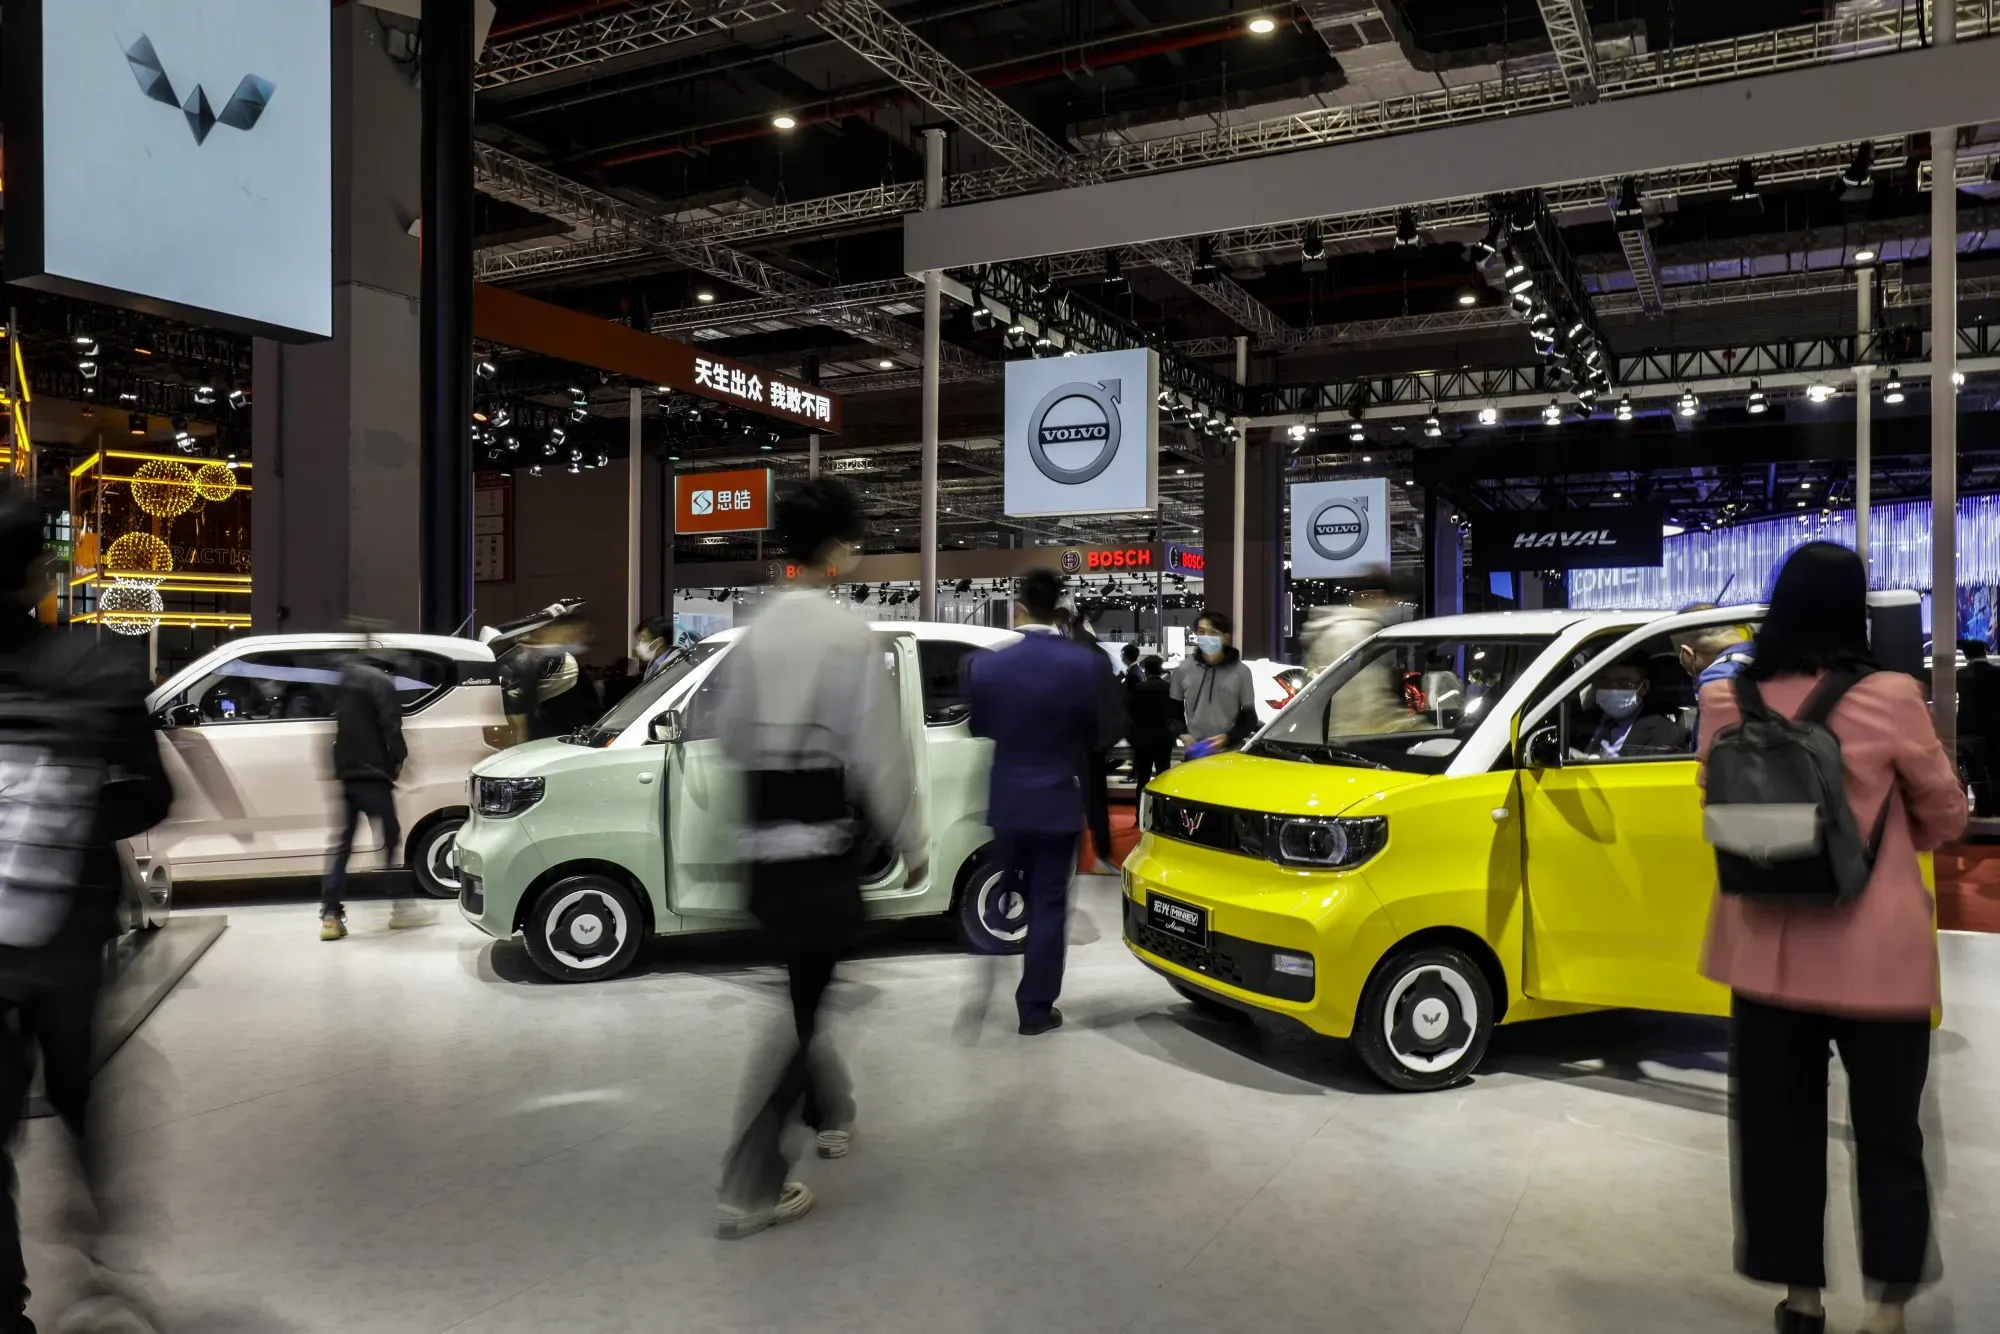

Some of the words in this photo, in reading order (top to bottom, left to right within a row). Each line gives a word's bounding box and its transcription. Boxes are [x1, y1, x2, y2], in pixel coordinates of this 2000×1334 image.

[695, 357, 763, 402] 天生出众
[770, 381, 831, 423] 我敢不同
[1042, 426, 1106, 441] VOLVO
[717, 490, 751, 511] 思皓
[1316, 524, 1359, 534] VOLVO
[1513, 529, 1617, 548] HAVAL
[1087, 549, 1150, 567] BOSCH
